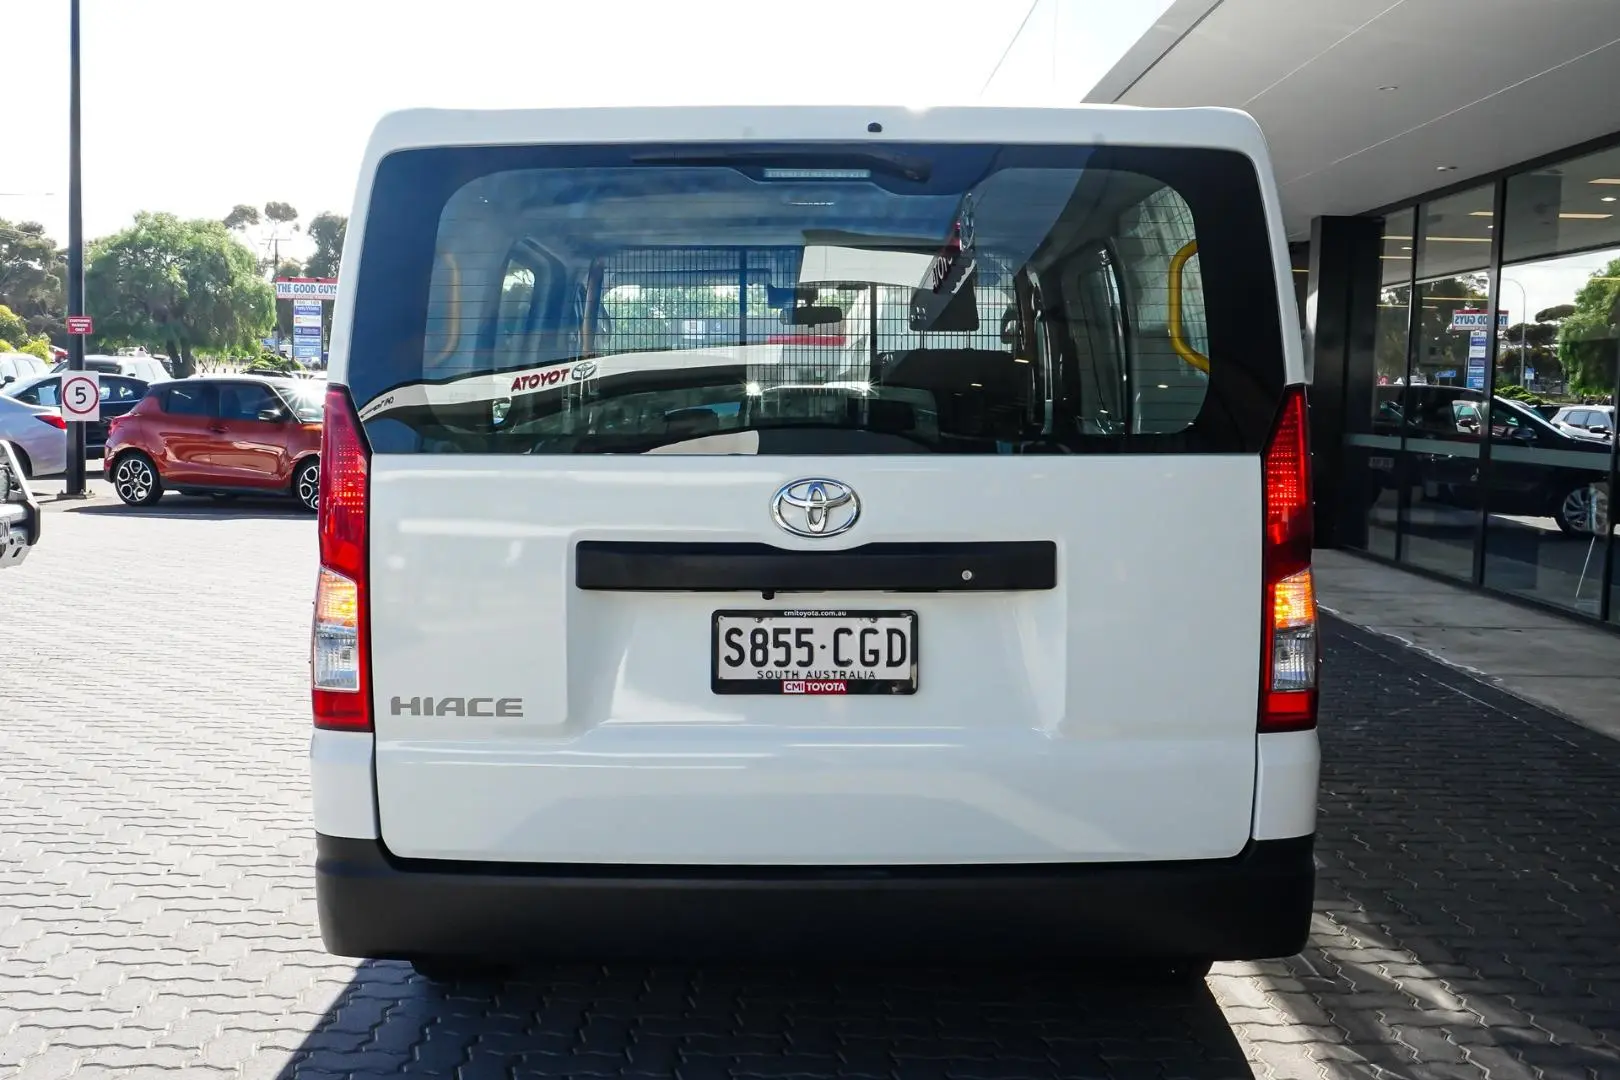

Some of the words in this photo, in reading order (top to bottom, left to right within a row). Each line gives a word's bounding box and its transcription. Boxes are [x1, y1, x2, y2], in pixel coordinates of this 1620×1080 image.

[277, 283, 291, 293] THE
[293, 284, 316, 294] GOOD
[75, 386, 87, 405] 5
[784, 610, 847, 618] cmitoyota.com.au
[757, 670, 800, 679] SOUTH
[805, 670, 876, 679] AUSTRALIA
[785, 682, 804, 692] CMI
[807, 682, 846, 692] TOYOTA
[390, 696, 524, 718] HIACE
